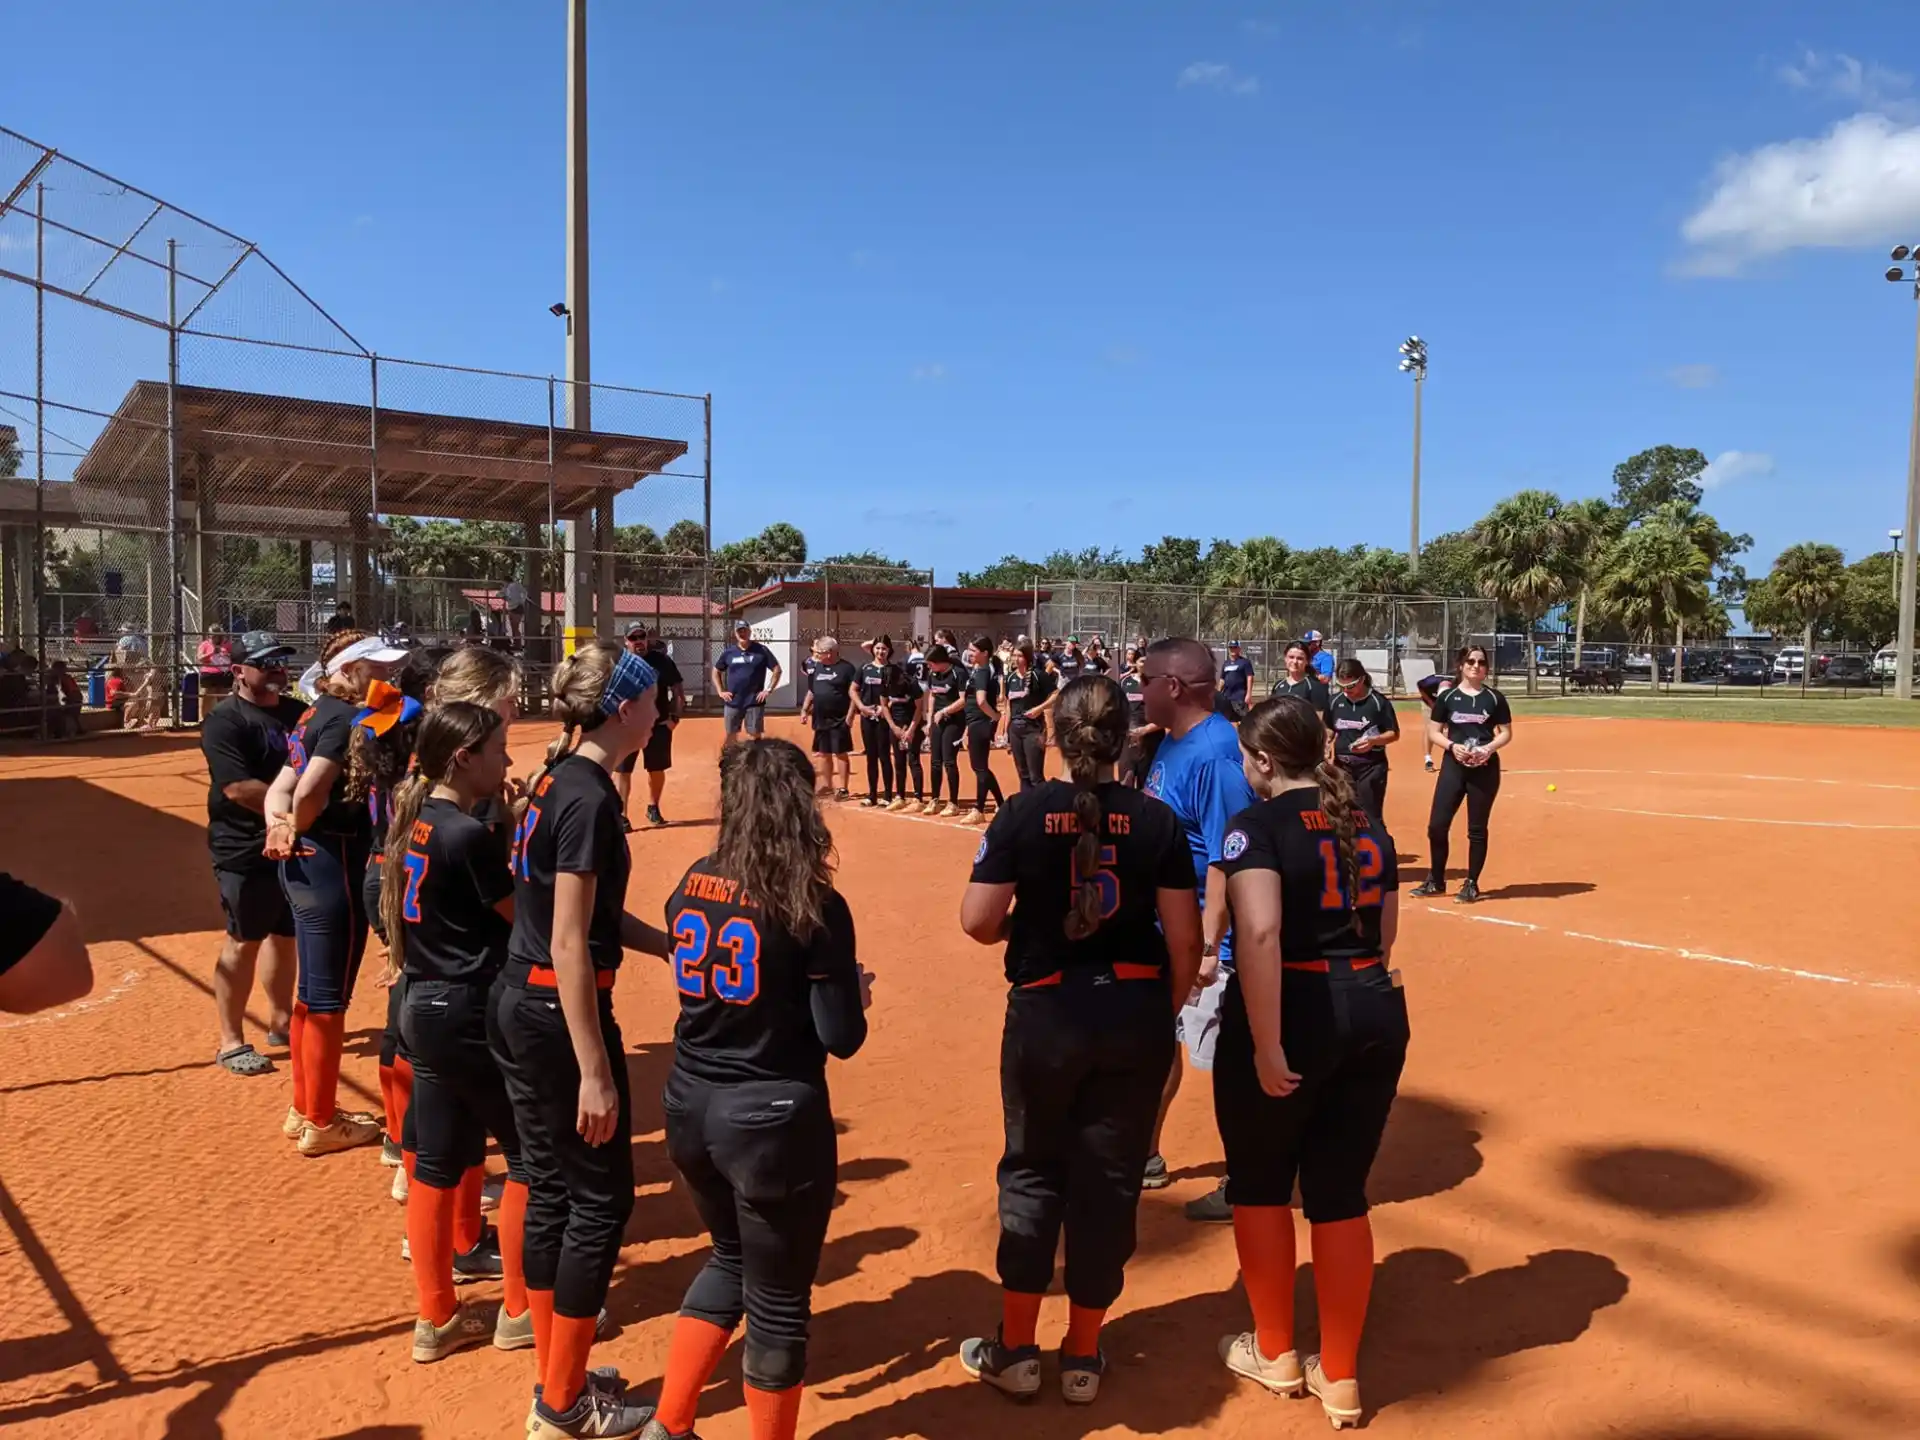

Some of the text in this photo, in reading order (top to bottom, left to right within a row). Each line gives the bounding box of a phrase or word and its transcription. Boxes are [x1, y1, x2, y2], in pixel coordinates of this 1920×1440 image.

[916, 663, 924, 680] 3
[1044, 812, 1130, 835] SYNE CTS
[403, 848, 430, 923] 7
[683, 871, 740, 904] SYNERGY
[1317, 833, 1385, 910] 12
[672, 908, 761, 1006] 23
